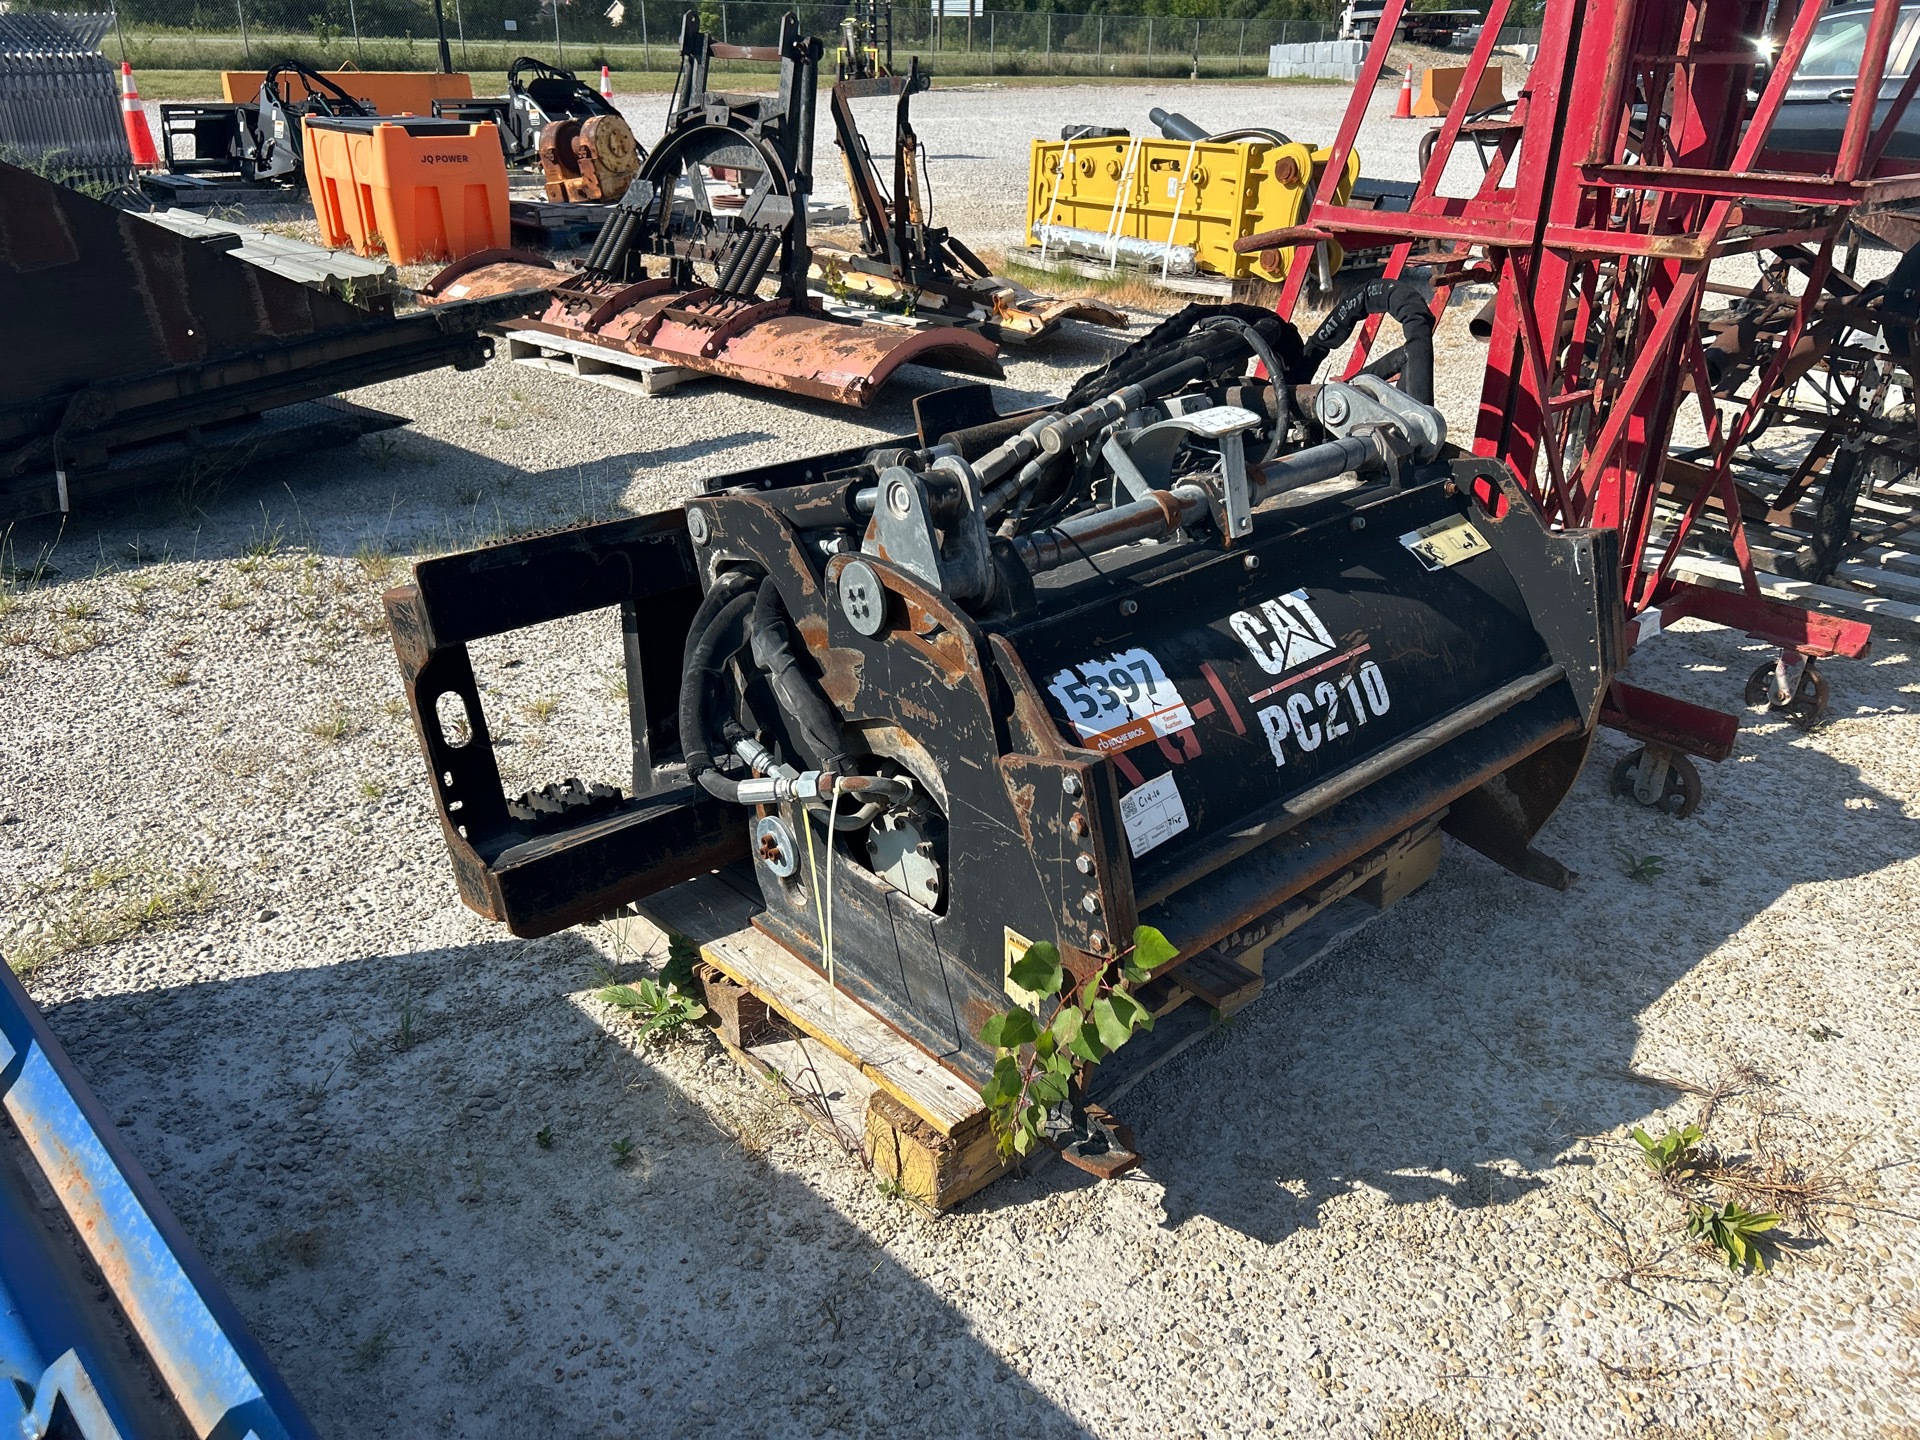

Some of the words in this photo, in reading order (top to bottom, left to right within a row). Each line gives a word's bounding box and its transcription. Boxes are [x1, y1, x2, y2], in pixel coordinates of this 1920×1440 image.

[421, 155, 434, 164] JQ
[436, 155, 469, 163] POWER
[1318, 316, 1339, 341] CAT
[1229, 588, 1336, 675] CAT
[1063, 659, 1158, 718] 5397
[1162, 713, 1178, 723] Timed
[1165, 720, 1183, 730] Auction
[1257, 660, 1390, 768] PC210
